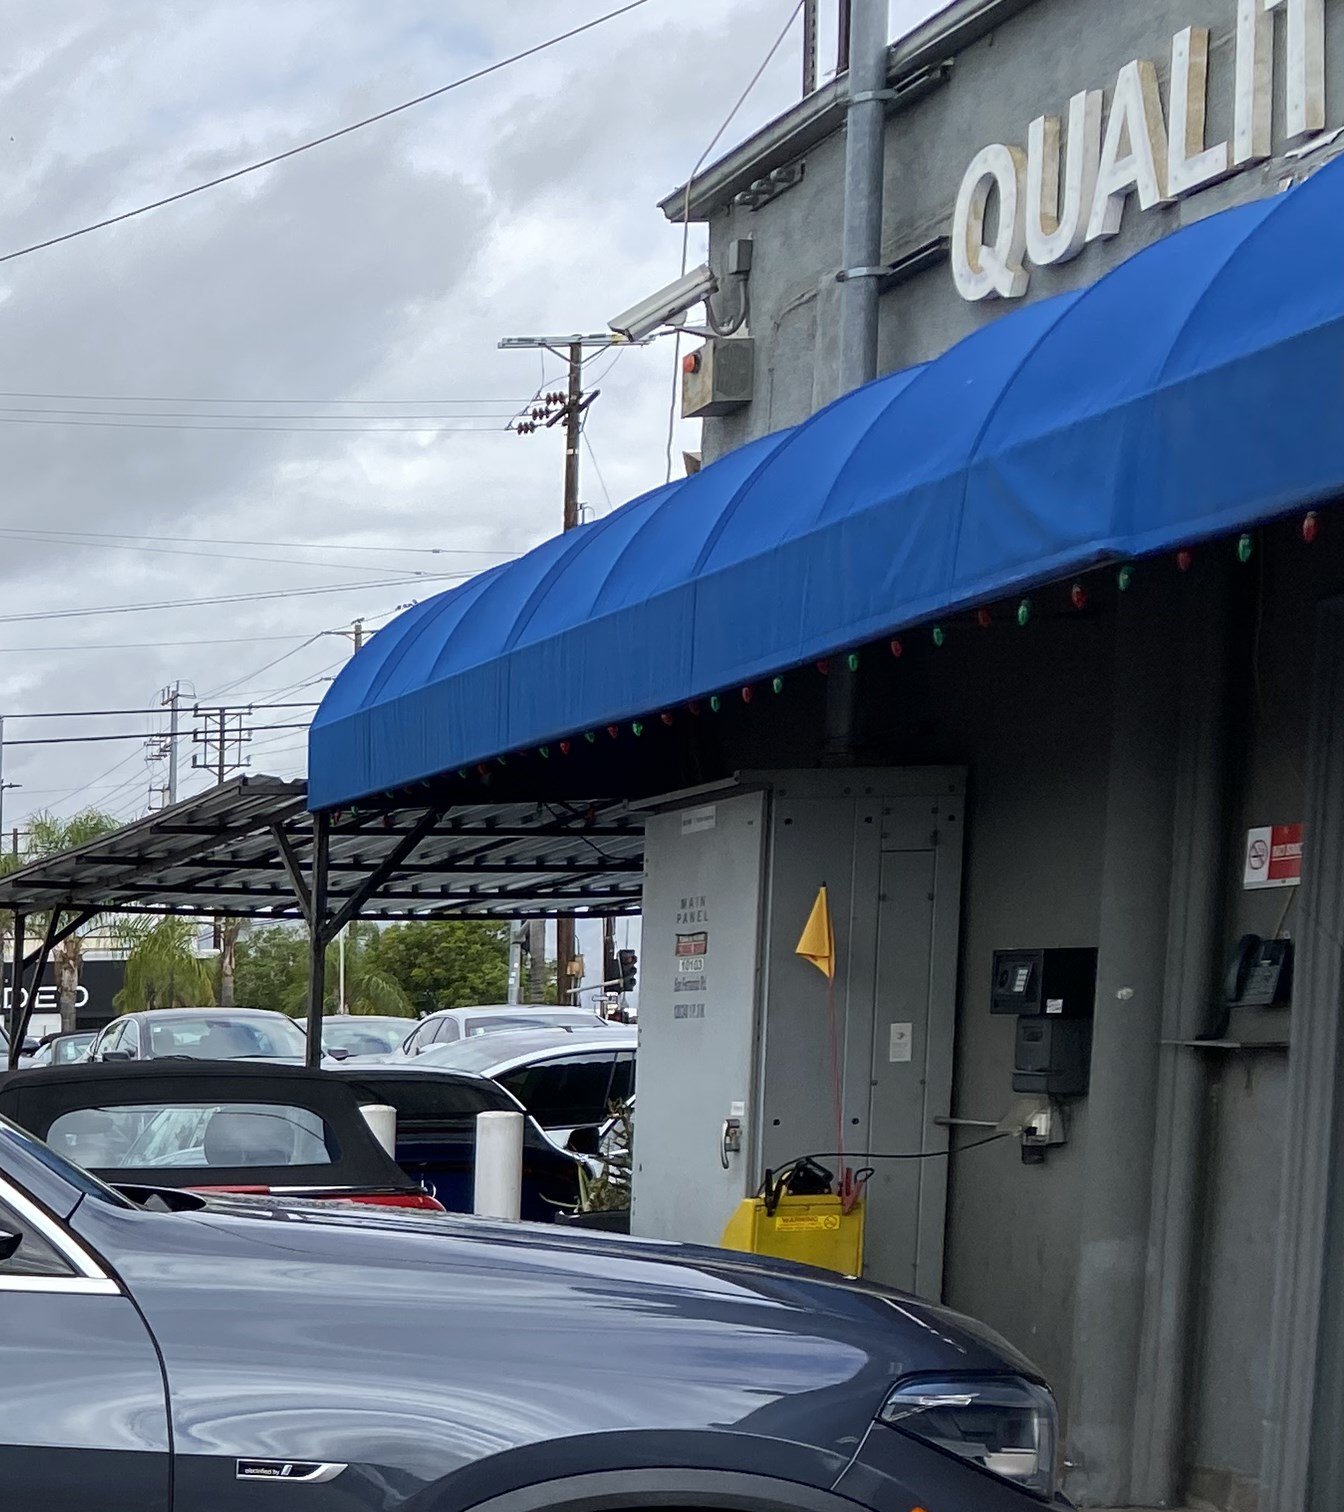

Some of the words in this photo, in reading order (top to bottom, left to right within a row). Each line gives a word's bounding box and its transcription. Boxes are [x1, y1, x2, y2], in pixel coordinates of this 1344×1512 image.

[952, 0, 1325, 301] QUALIT
[680, 896, 706, 910] MAIN
[676, 910, 708, 924] PANEL
